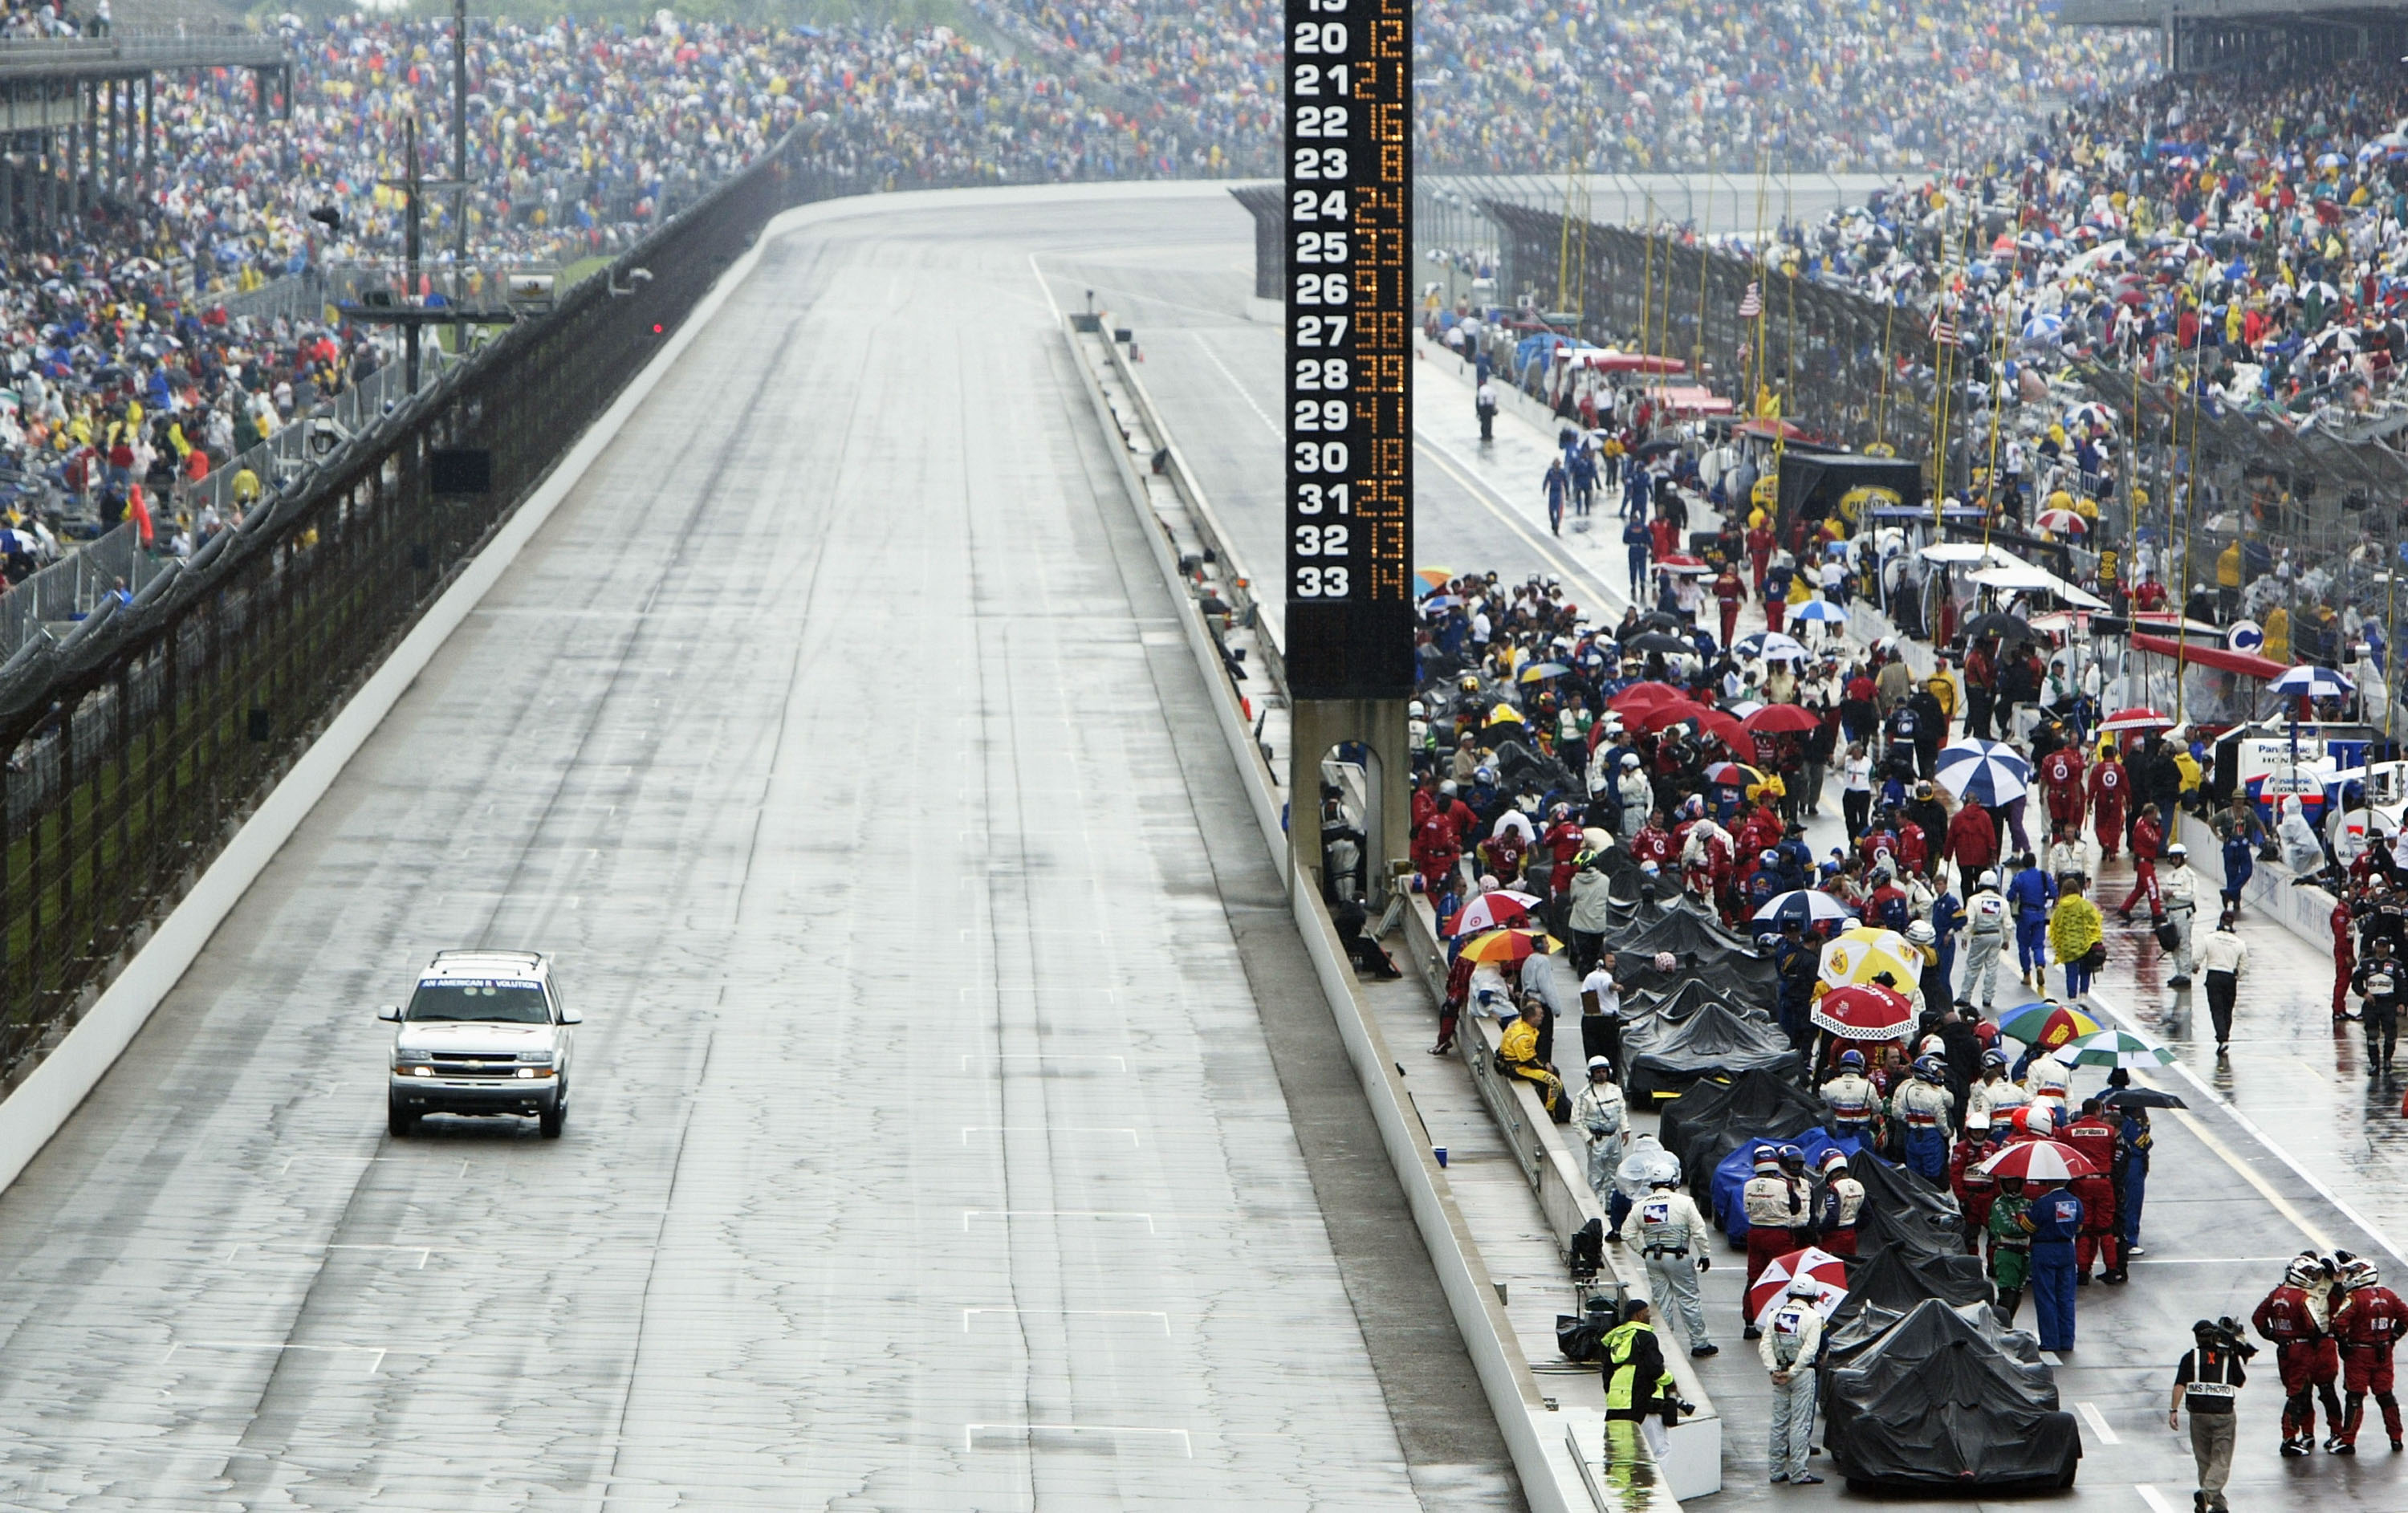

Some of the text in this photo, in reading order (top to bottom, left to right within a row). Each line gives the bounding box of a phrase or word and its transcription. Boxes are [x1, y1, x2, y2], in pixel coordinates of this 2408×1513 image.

[1294, 20, 1402, 57] 20 12
[1295, 62, 1403, 99] 21 21
[1296, 103, 1403, 141] 22 16
[1295, 145, 1402, 182] 23 8
[1293, 187, 1402, 223] 24 24
[1296, 228, 1402, 265] 25 33
[1296, 270, 1402, 307] 26 91
[1296, 312, 1403, 348] 27 98
[1296, 356, 1403, 392] 28 39
[1295, 397, 1403, 433] 29 41
[1295, 439, 1403, 476] 30 18
[1298, 480, 1403, 516] 31 25
[1296, 522, 1403, 559] 32 13
[1296, 563, 1403, 599] 33 14
[485, 981, 538, 989] RVOLUTION
[2207, 1384, 2230, 1394] PHOTO
